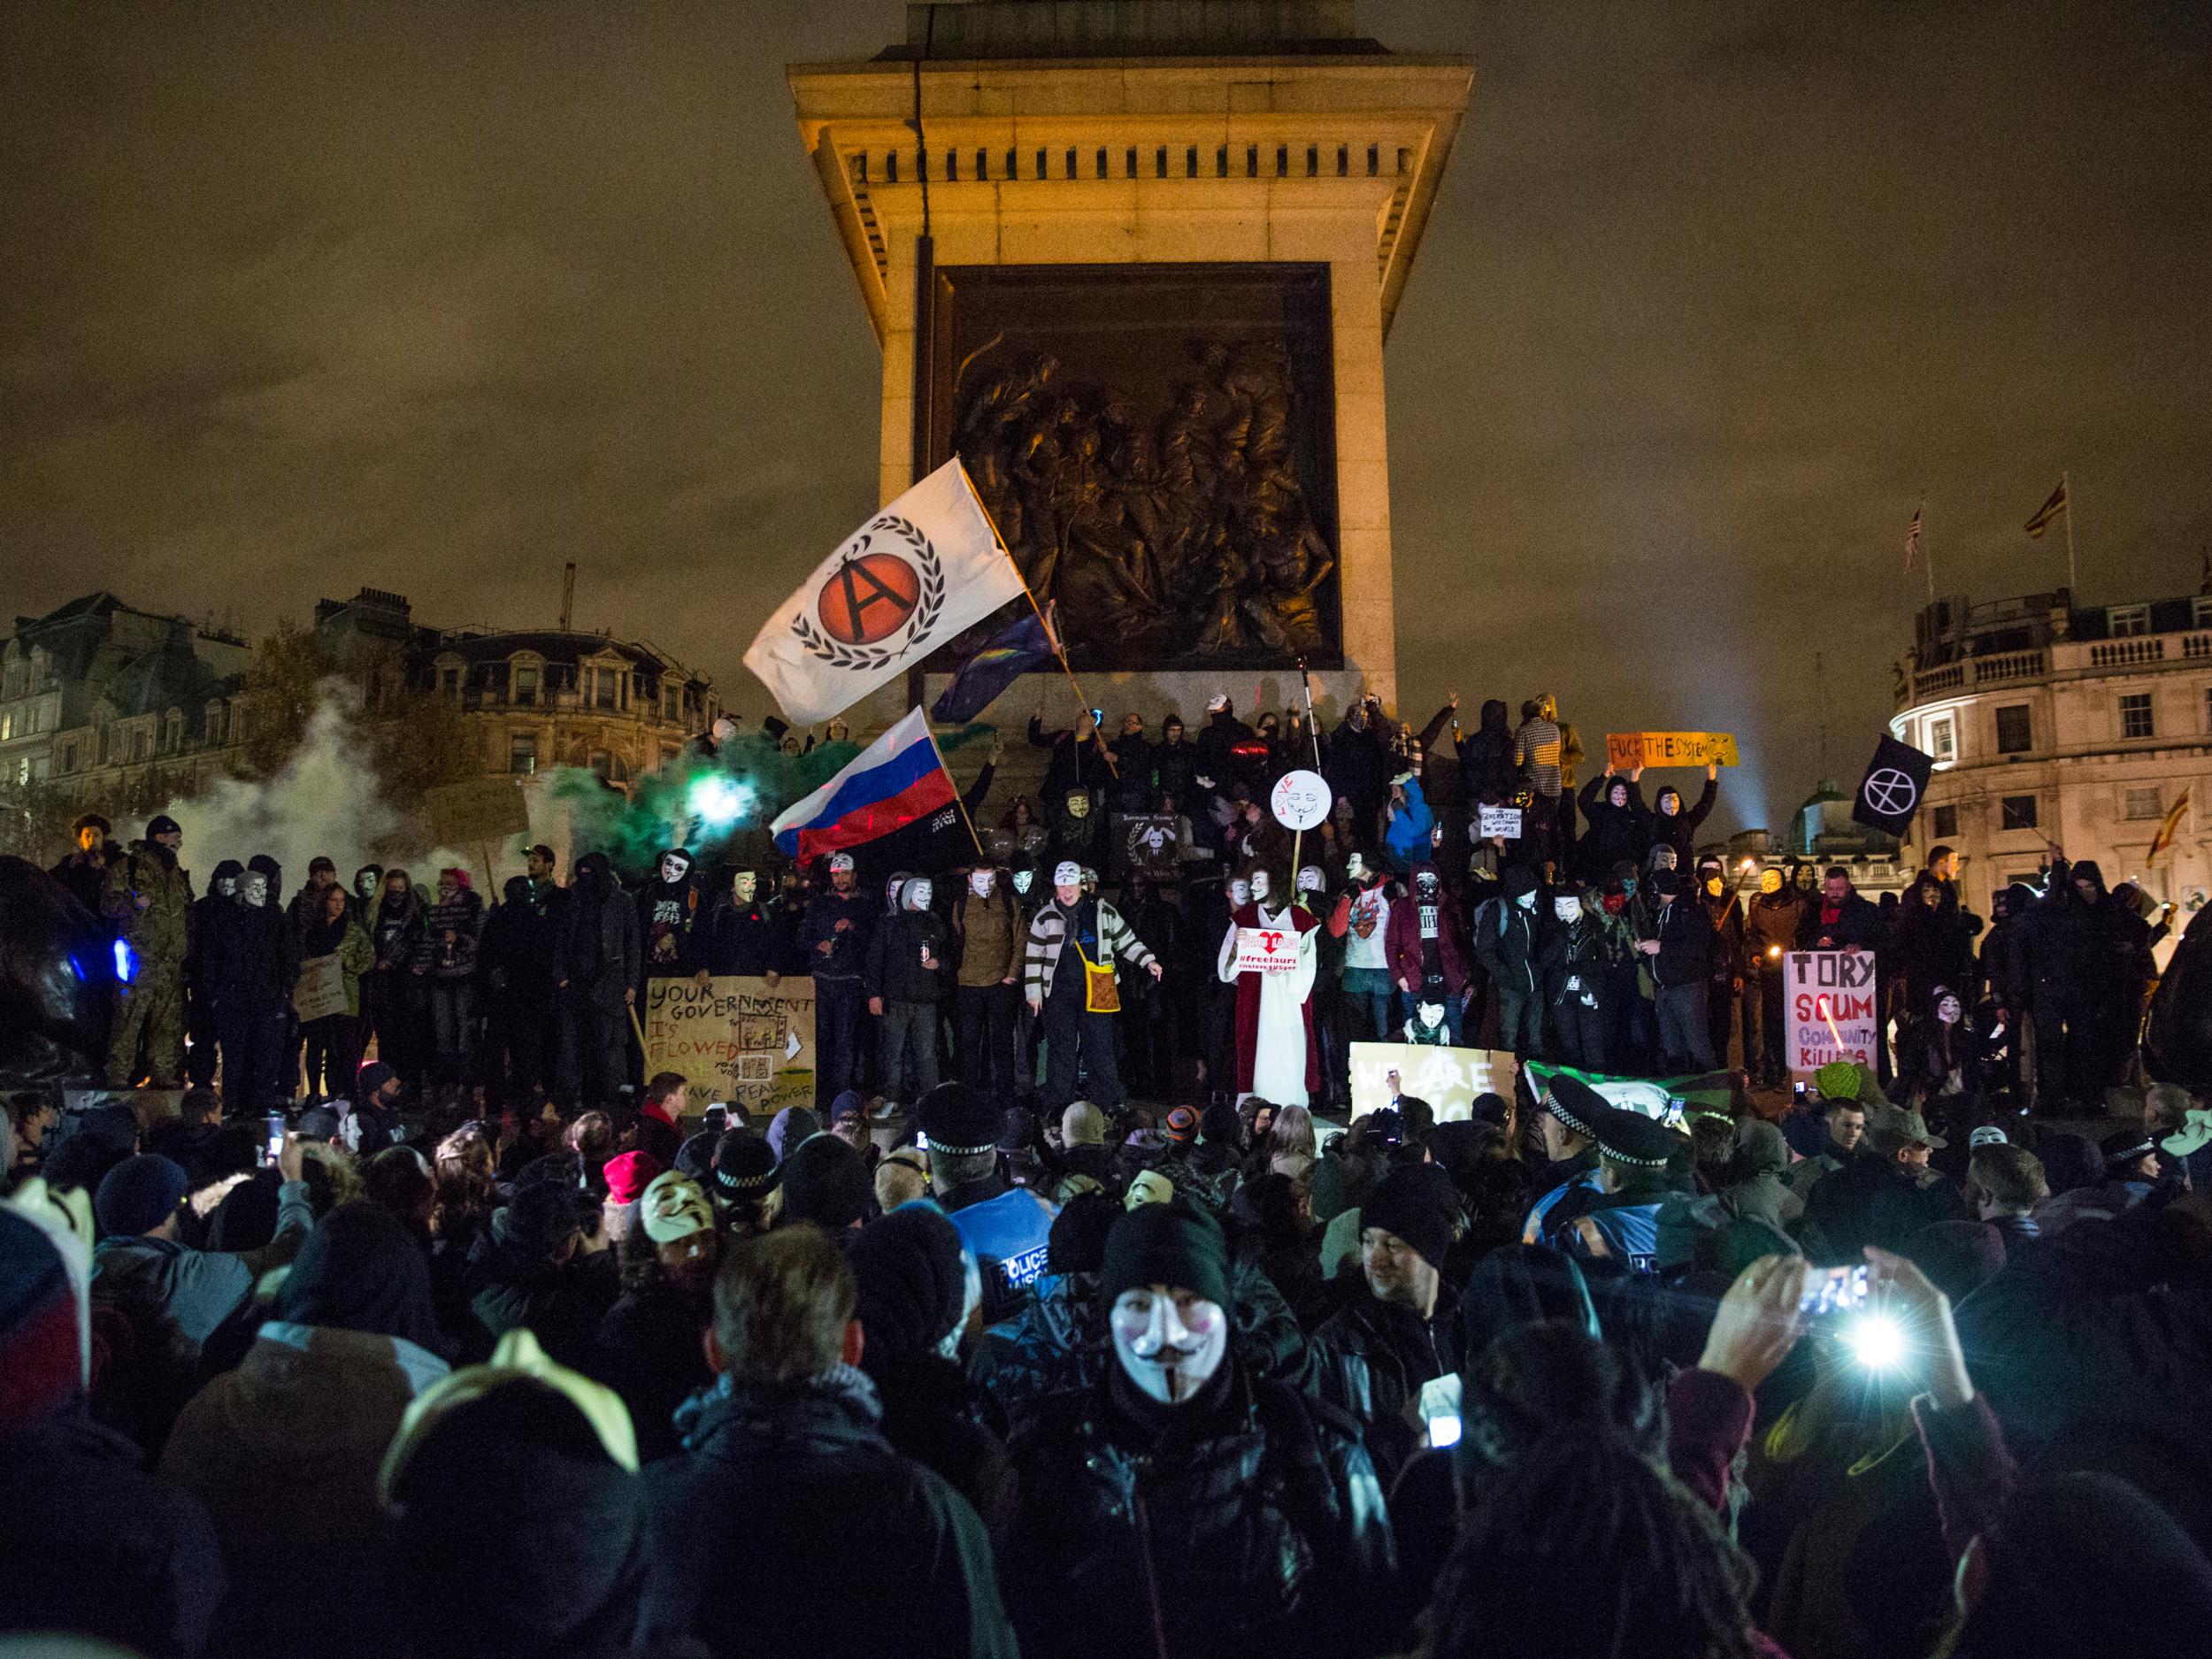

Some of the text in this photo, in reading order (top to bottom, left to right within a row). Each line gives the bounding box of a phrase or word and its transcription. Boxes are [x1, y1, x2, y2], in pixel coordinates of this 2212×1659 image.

[1609, 737, 1709, 764] FUCK THE SYSTEM
[1240, 956, 1296, 964] #freelauri
[1792, 953, 1875, 987] TORY
[650, 983, 715, 1010] YOUR
[671, 995, 815, 1020] GOVERNMENT
[1795, 993, 1873, 1023] SCUM
[649, 1040, 740, 1062] FLOWED
[688, 1085, 722, 1102] AVE
[760, 1085, 813, 1112] POWER
[1001, 1248, 1048, 1280] POLICE
